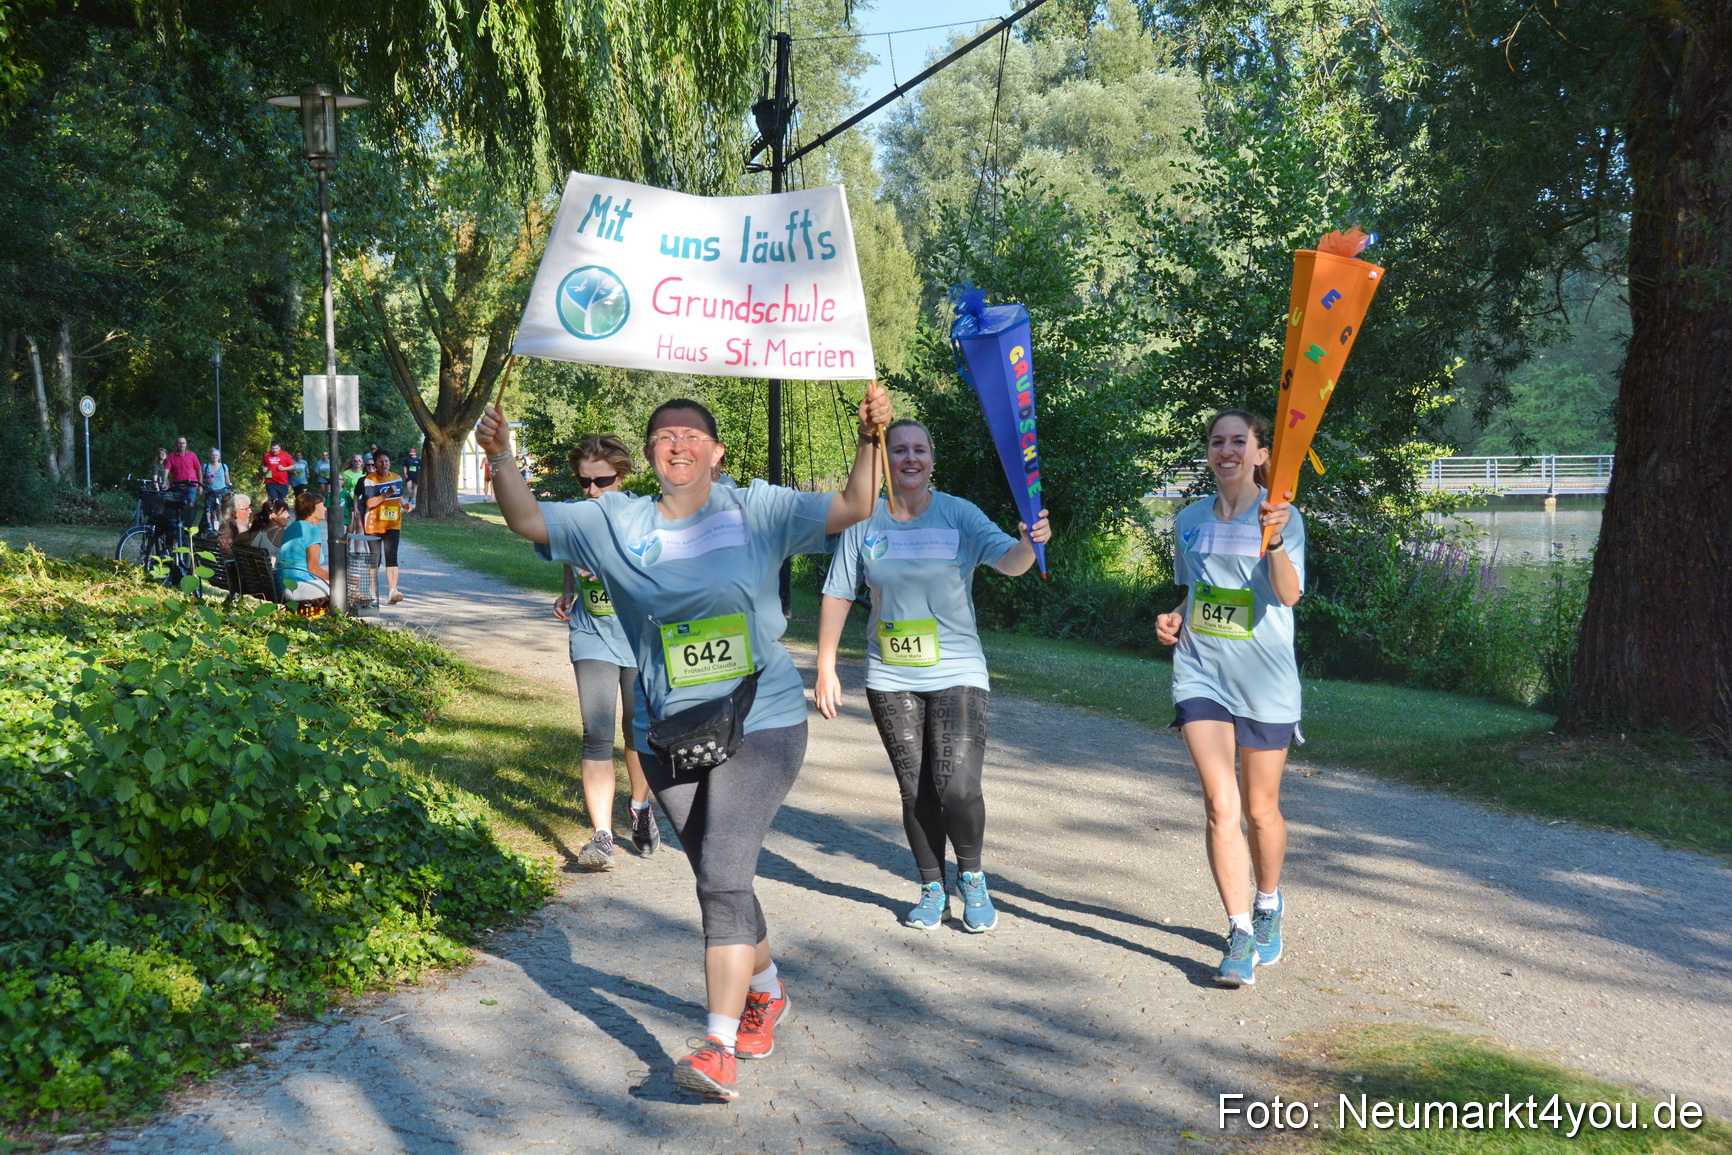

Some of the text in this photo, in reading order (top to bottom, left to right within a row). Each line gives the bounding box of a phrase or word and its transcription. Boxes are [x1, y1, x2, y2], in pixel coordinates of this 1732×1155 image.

[577, 193, 837, 263] Mit uns läufts
[652, 276, 836, 324] Grundschule
[656, 335, 855, 368] Haus St. Marien
[1009, 345, 1044, 499] GRUNDSCHULE
[1202, 602, 1236, 624] 647
[683, 639, 732, 667] 642
[890, 636, 922, 653] 641
[711, 661, 737, 671] Claudia
